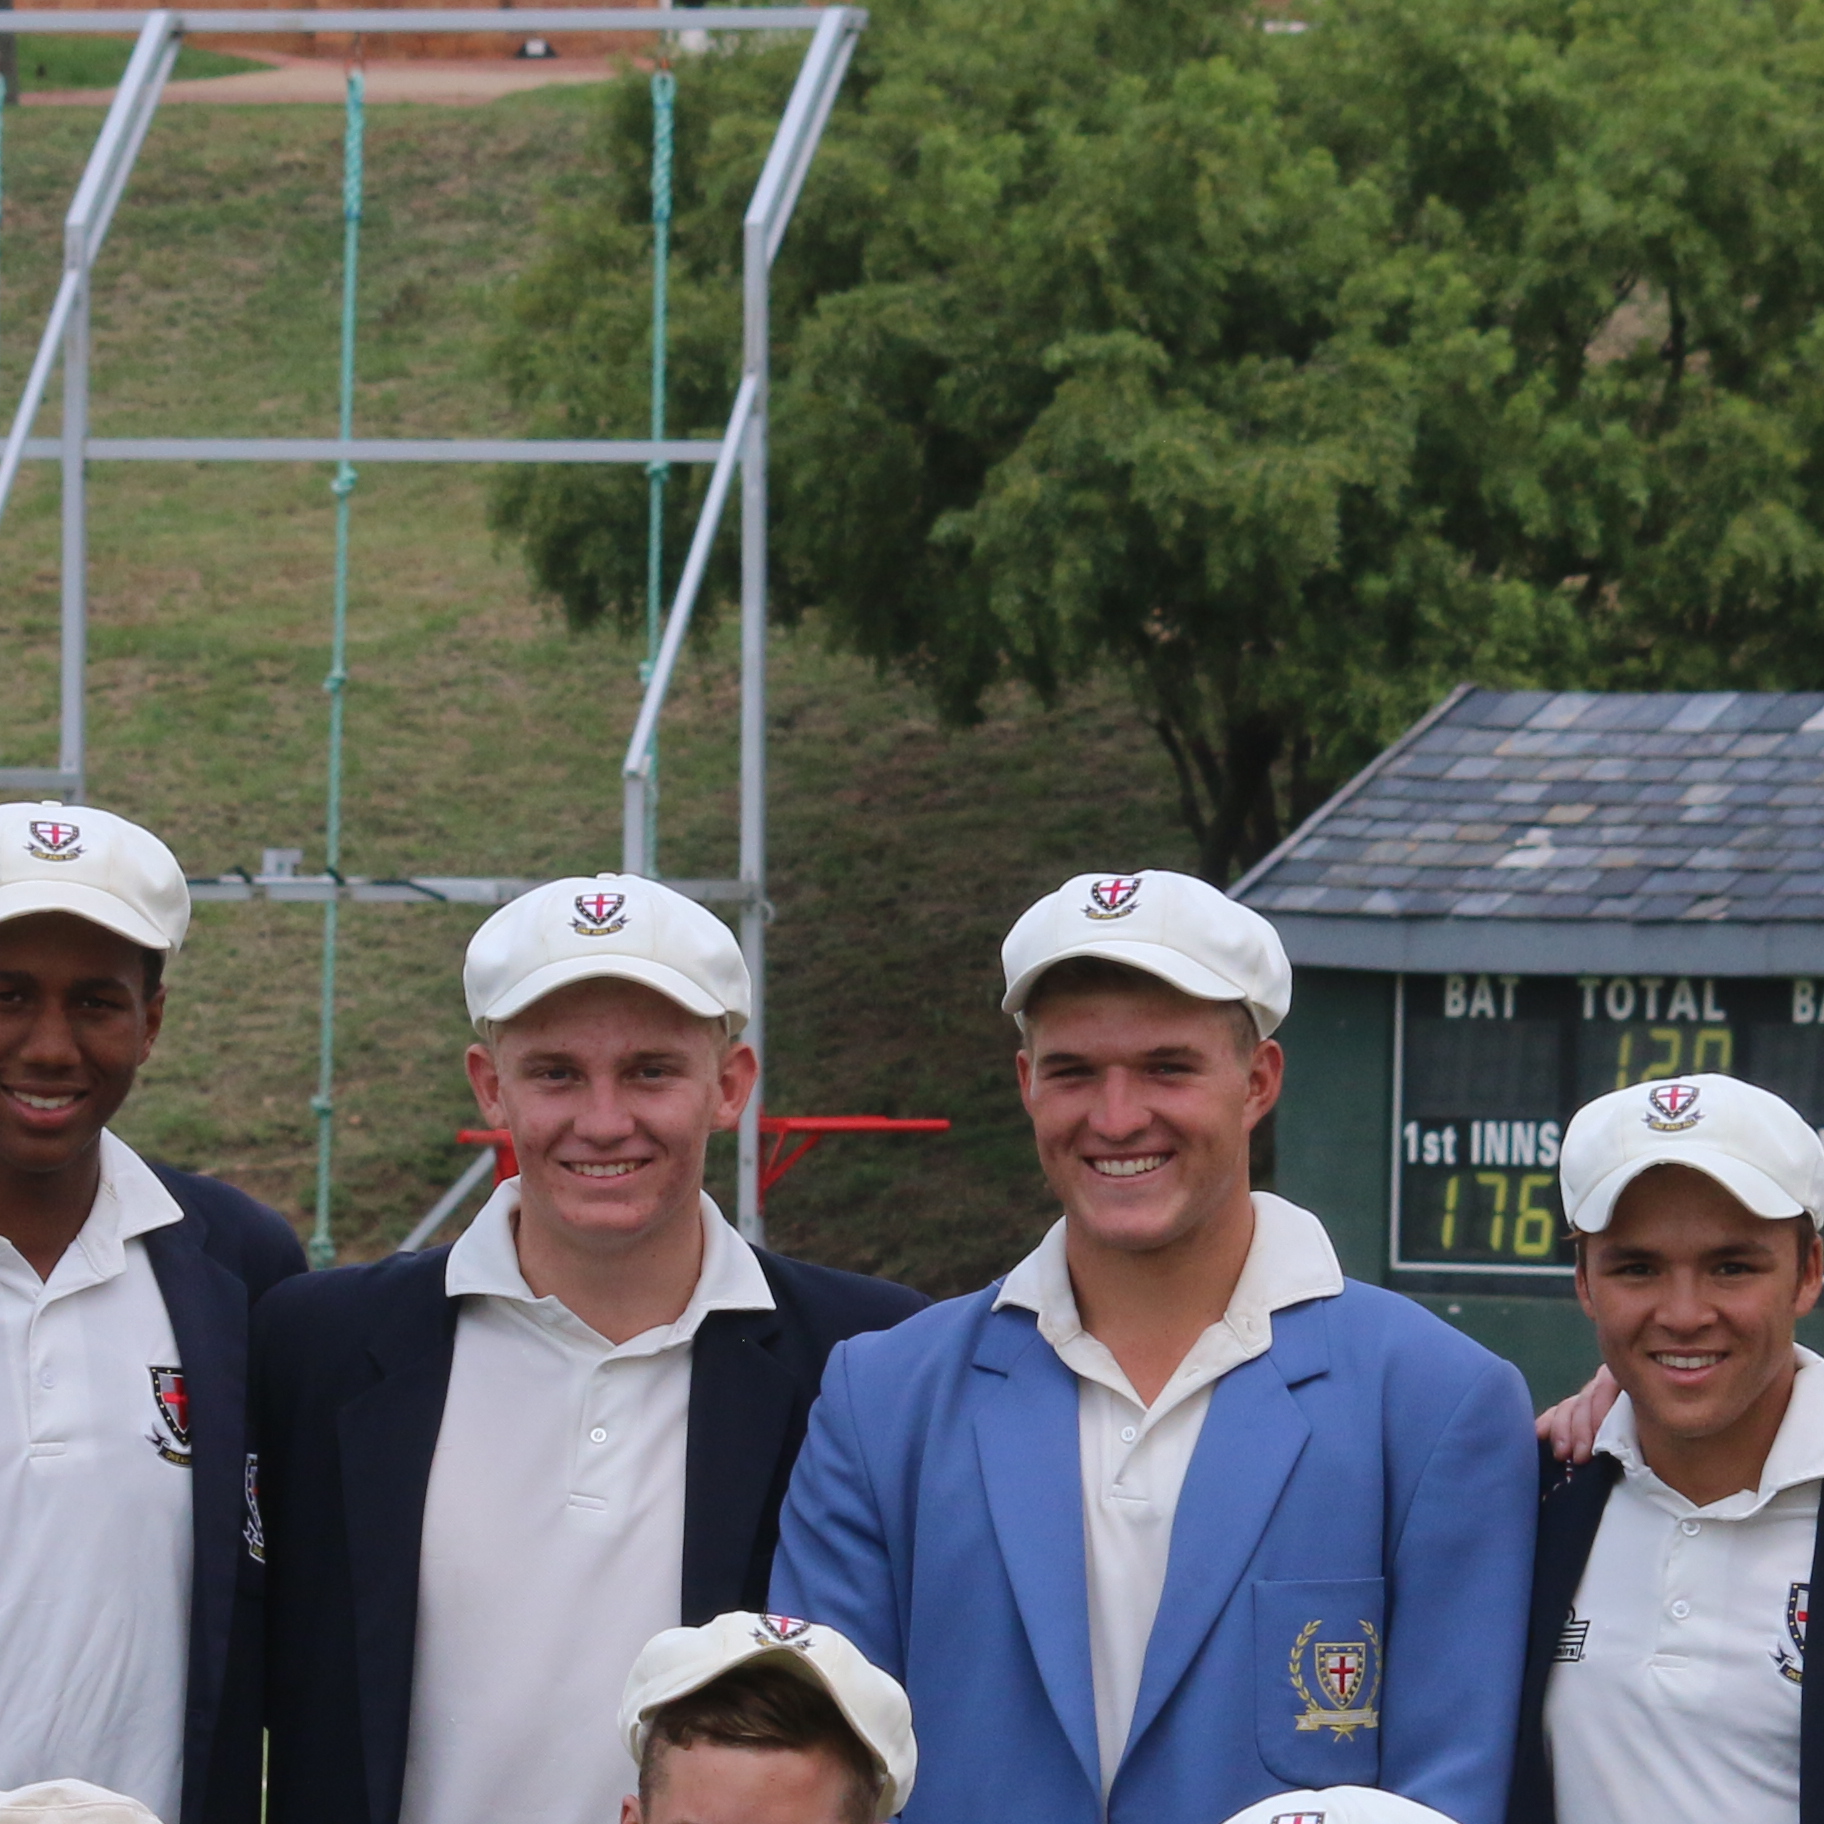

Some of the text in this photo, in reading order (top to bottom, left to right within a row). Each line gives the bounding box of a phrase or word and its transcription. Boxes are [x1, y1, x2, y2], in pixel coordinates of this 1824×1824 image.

[1444, 975, 1520, 1019] BAT
[1578, 977, 1726, 1022] TOTAL
[1404, 1120, 1561, 1167] 1st INNS
[1441, 1172, 1554, 1256] 176
